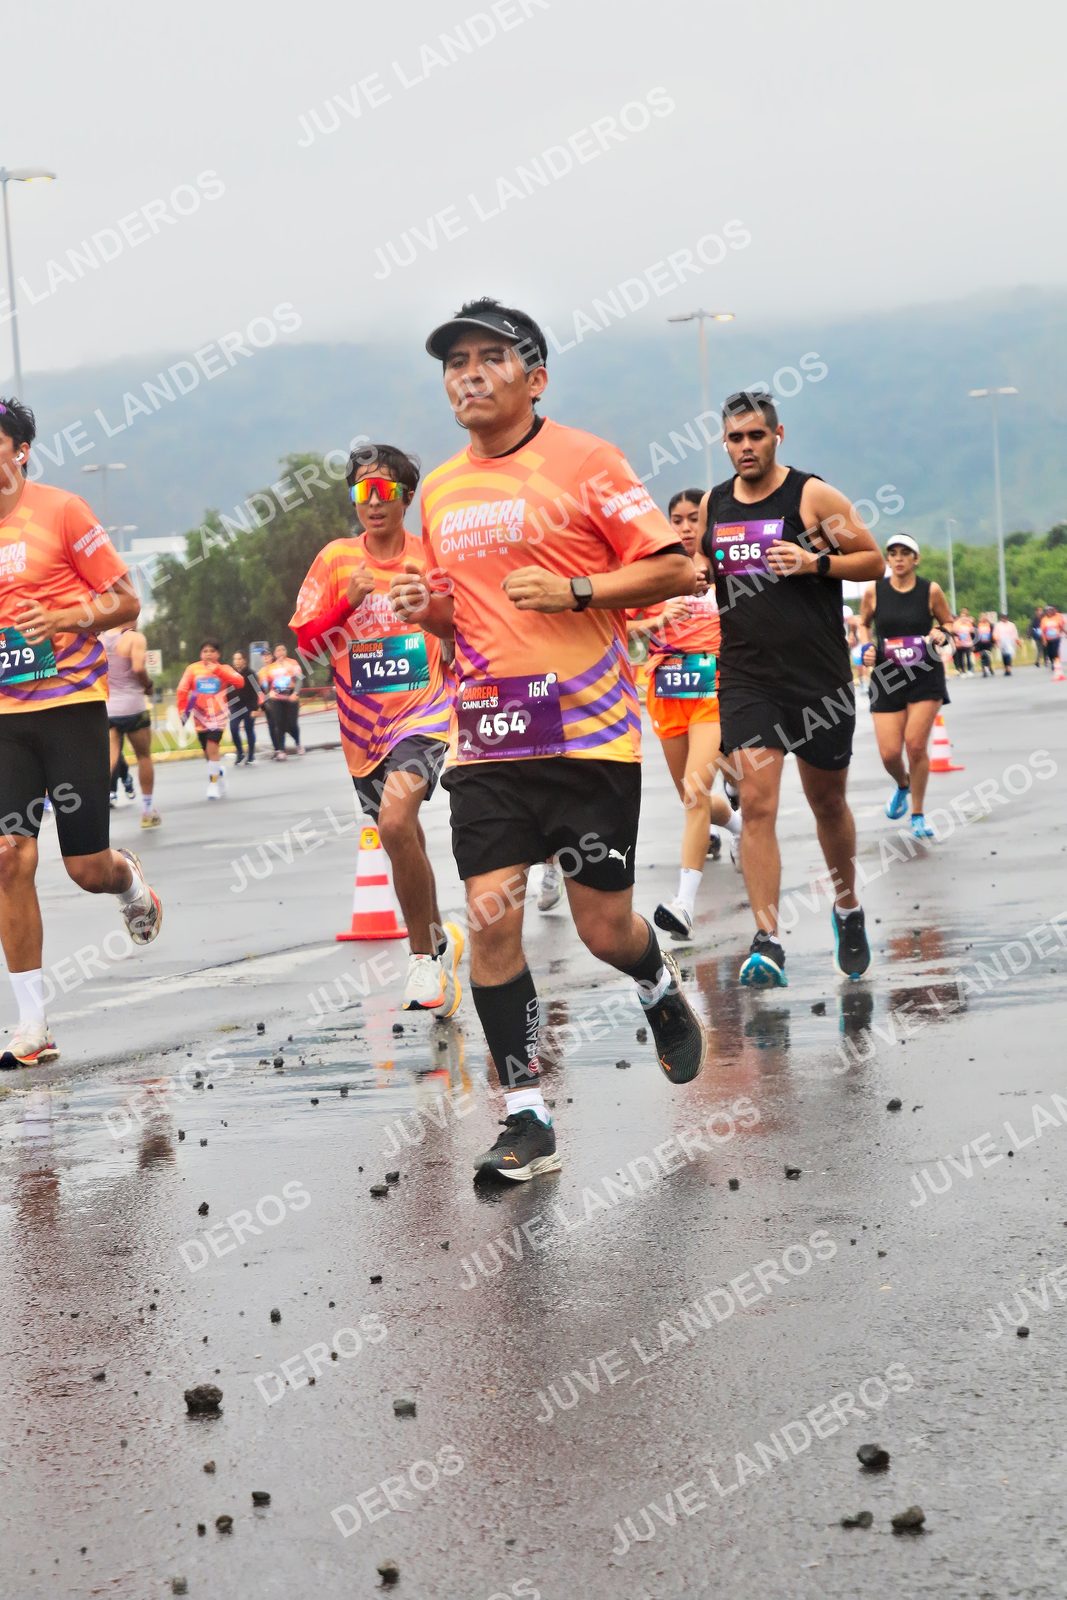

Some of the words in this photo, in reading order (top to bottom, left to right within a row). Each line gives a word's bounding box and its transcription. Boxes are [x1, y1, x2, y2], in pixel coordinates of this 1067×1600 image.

[440, 498, 526, 536] CARRERA
[728, 543, 762, 561] 636
[404, 638, 420, 651] 10K
[362, 658, 410, 679] 1429
[664, 672, 701, 686] 1317
[463, 685, 499, 701] CARRERA
[479, 711, 527, 737] 464
